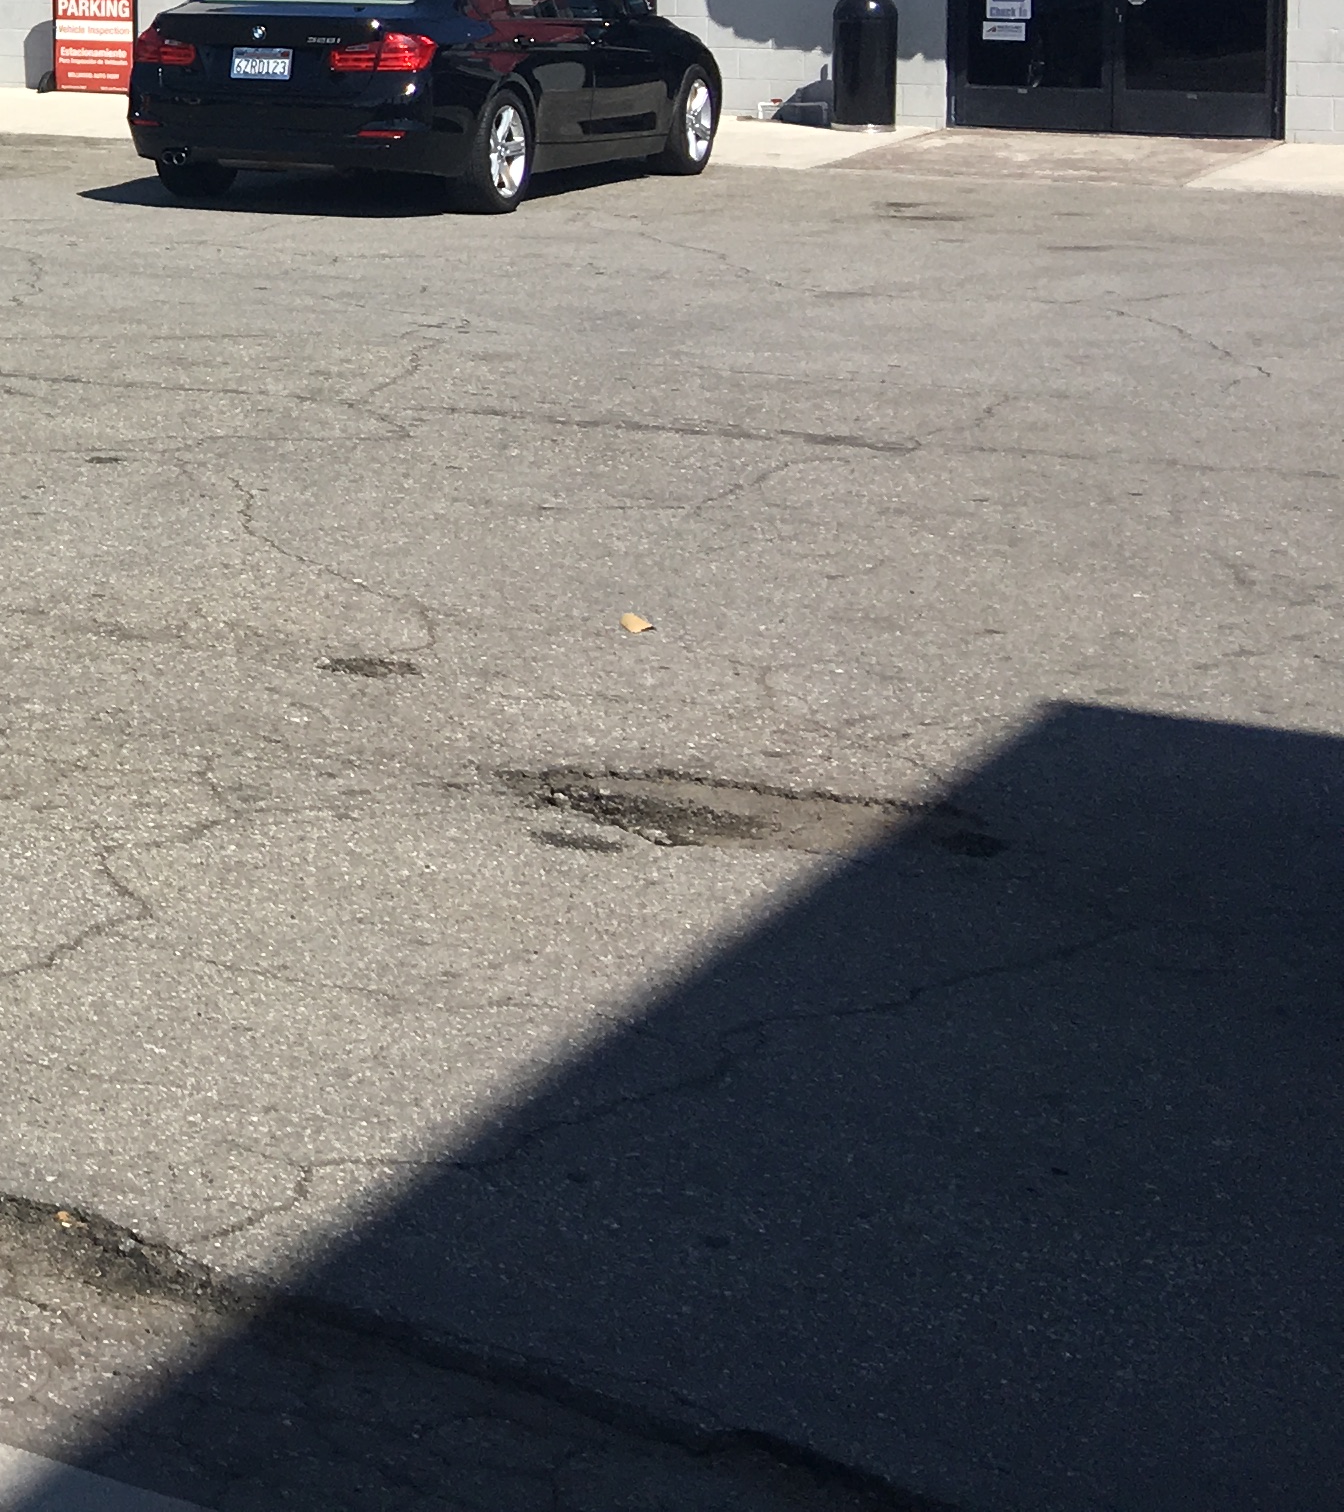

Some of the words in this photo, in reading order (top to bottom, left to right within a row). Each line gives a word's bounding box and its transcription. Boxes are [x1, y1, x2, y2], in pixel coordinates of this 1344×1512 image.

[59, 25, 85, 34] Vehicle
[88, 25, 130, 35] Inspection
[60, 46, 127, 59] Estacionamiento
[235, 59, 287, 74] 6ZRD123
